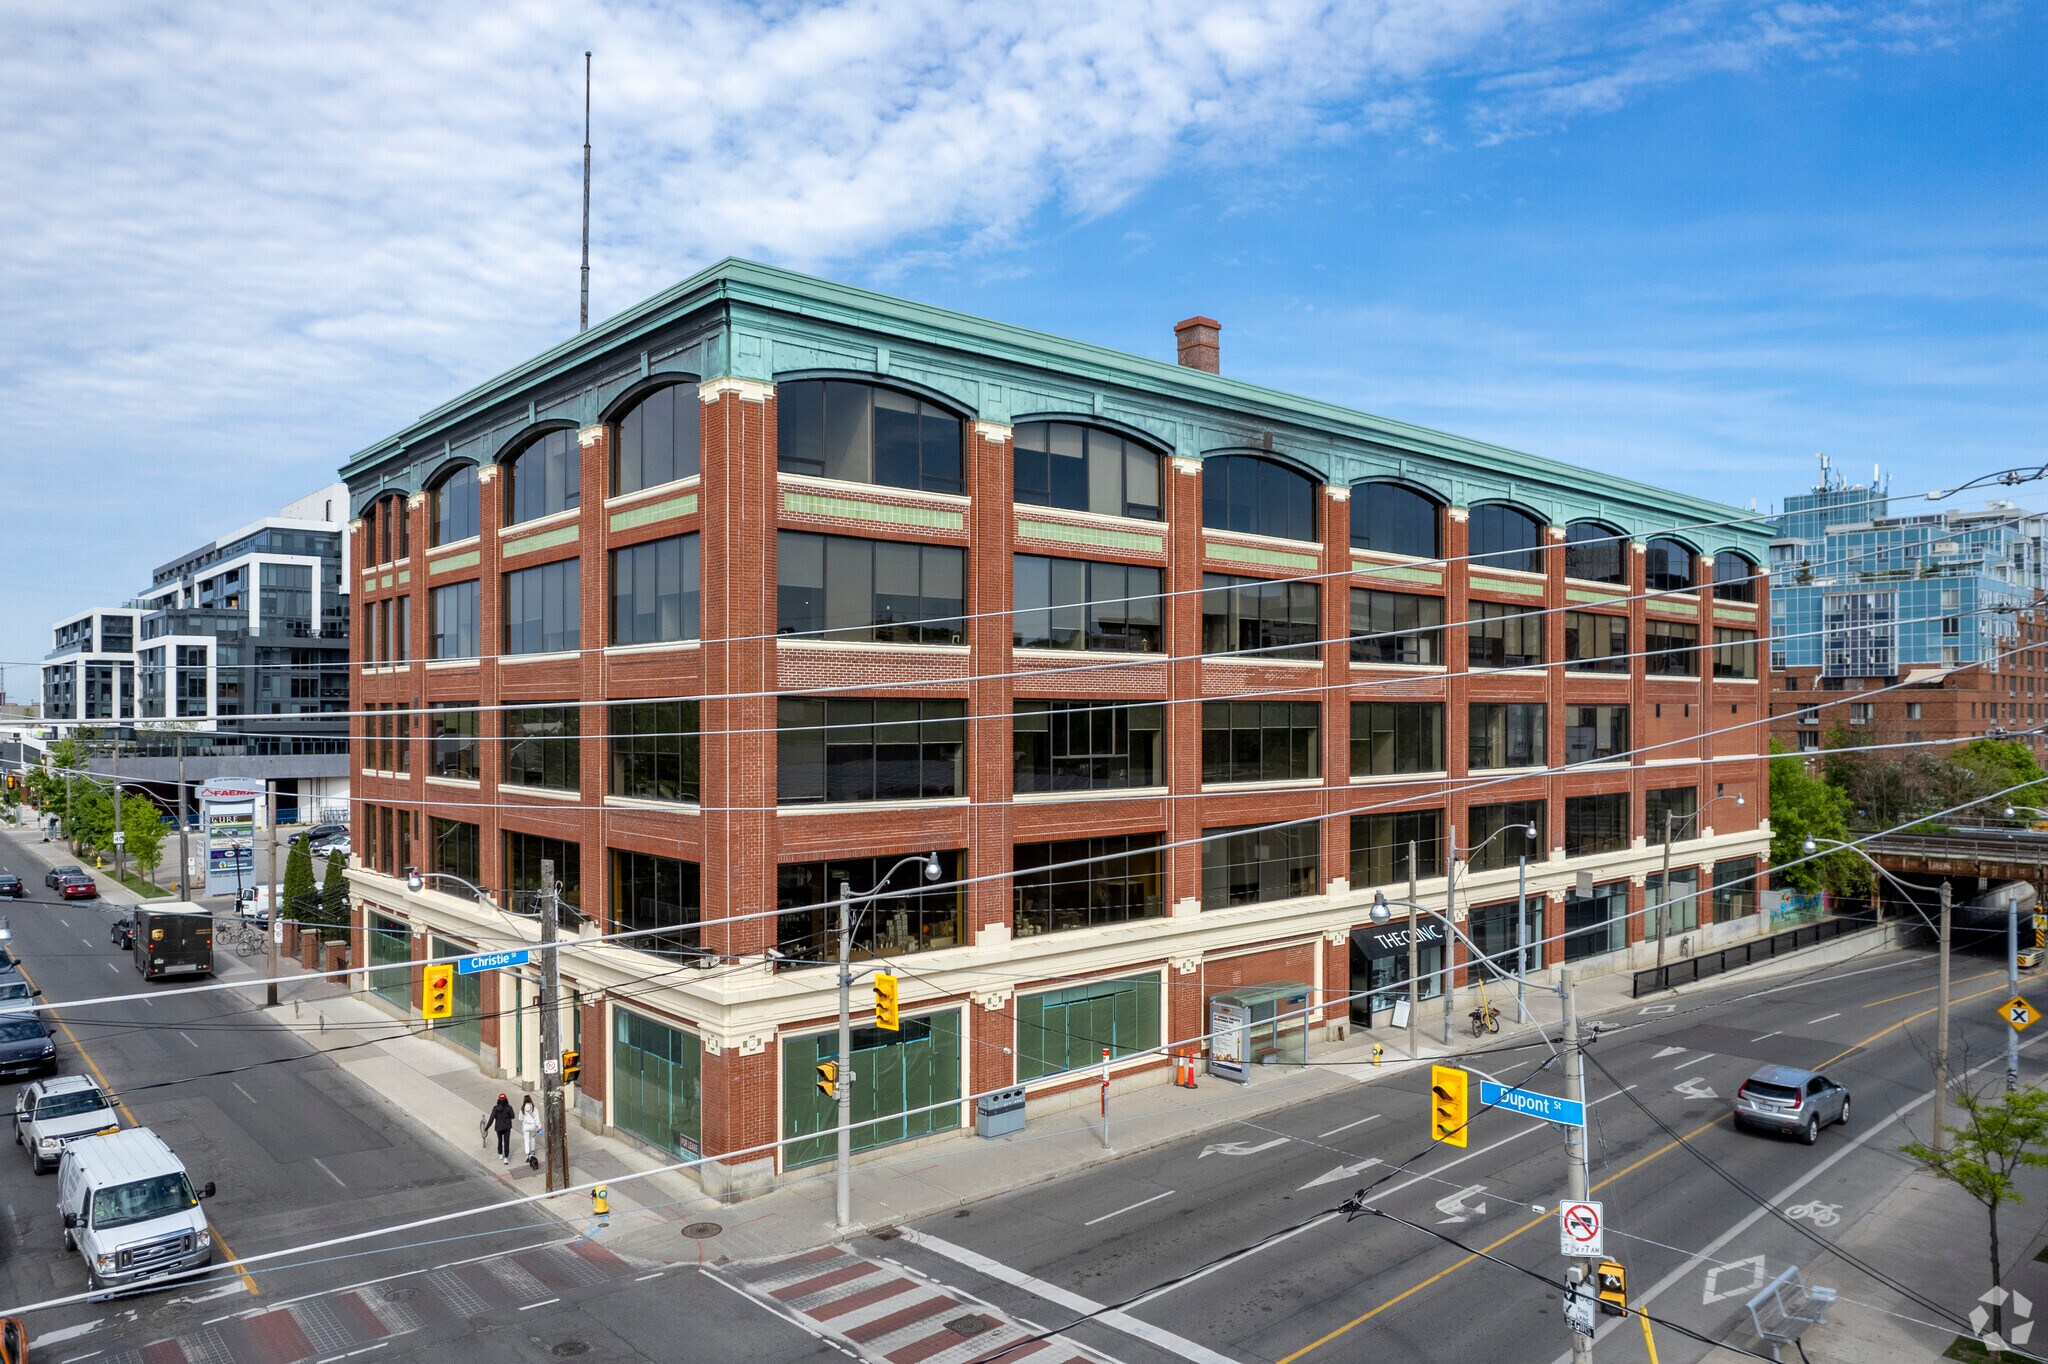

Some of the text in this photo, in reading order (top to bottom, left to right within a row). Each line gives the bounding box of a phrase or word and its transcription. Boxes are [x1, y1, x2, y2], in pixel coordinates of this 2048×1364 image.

[471, 953, 510, 968] Christie
[1500, 1087, 1562, 1114] Dupont St
[688, 1139, 699, 1153] LEASE
[1584, 1244, 1590, 1253] 7
[1577, 1306, 1589, 1317] THIS
[1565, 1315, 1593, 1337] BEGINS
[1575, 1313, 1589, 1325] LANE
